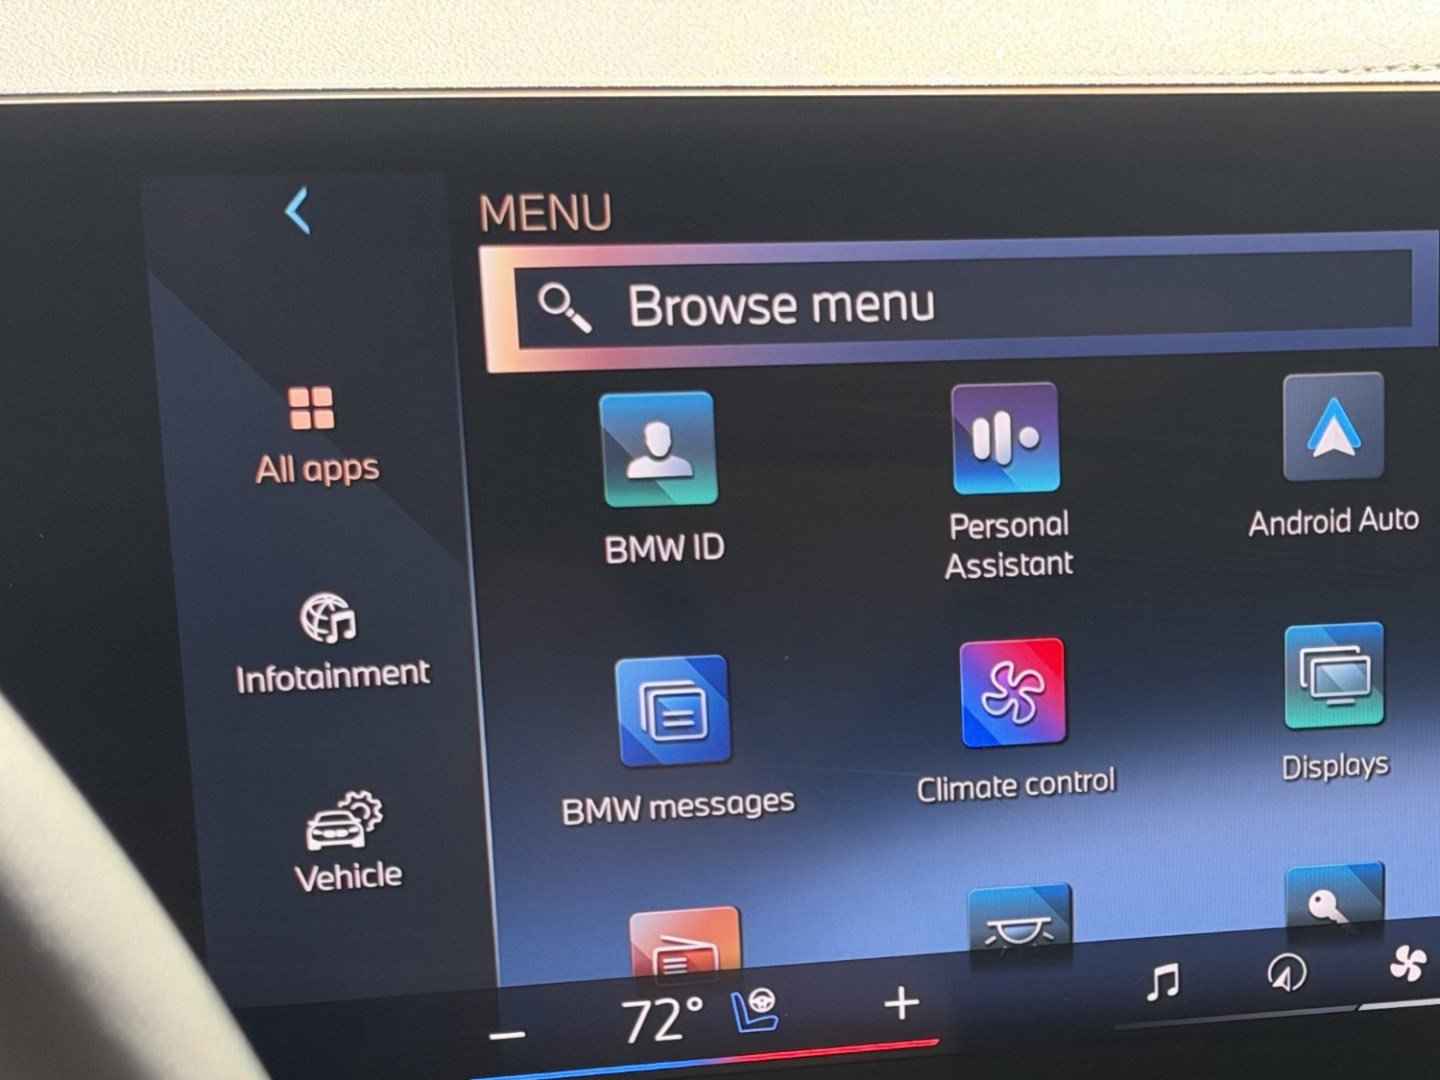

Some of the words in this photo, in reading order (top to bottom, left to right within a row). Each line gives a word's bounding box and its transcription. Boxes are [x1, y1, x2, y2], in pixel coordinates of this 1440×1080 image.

[479, 193, 613, 232] MENU
[628, 283, 798, 328] Browse
[812, 285, 936, 322] menu
[254, 453, 294, 485] All
[302, 453, 381, 487] apps
[949, 509, 1070, 540] Personal
[1249, 506, 1351, 538] Android
[1358, 506, 1421, 535] Auto
[604, 535, 685, 564] BMW
[693, 532, 725, 562] ID
[945, 550, 1074, 581] Assistant
[236, 658, 431, 695] Infotainment
[1281, 752, 1390, 784] Displays
[916, 770, 1018, 805] Climate
[1024, 767, 1116, 797] control
[561, 795, 642, 826] BMW
[649, 789, 796, 821] messages
[294, 860, 403, 892] Vehicle
[620, 996, 704, 1046] 72°
